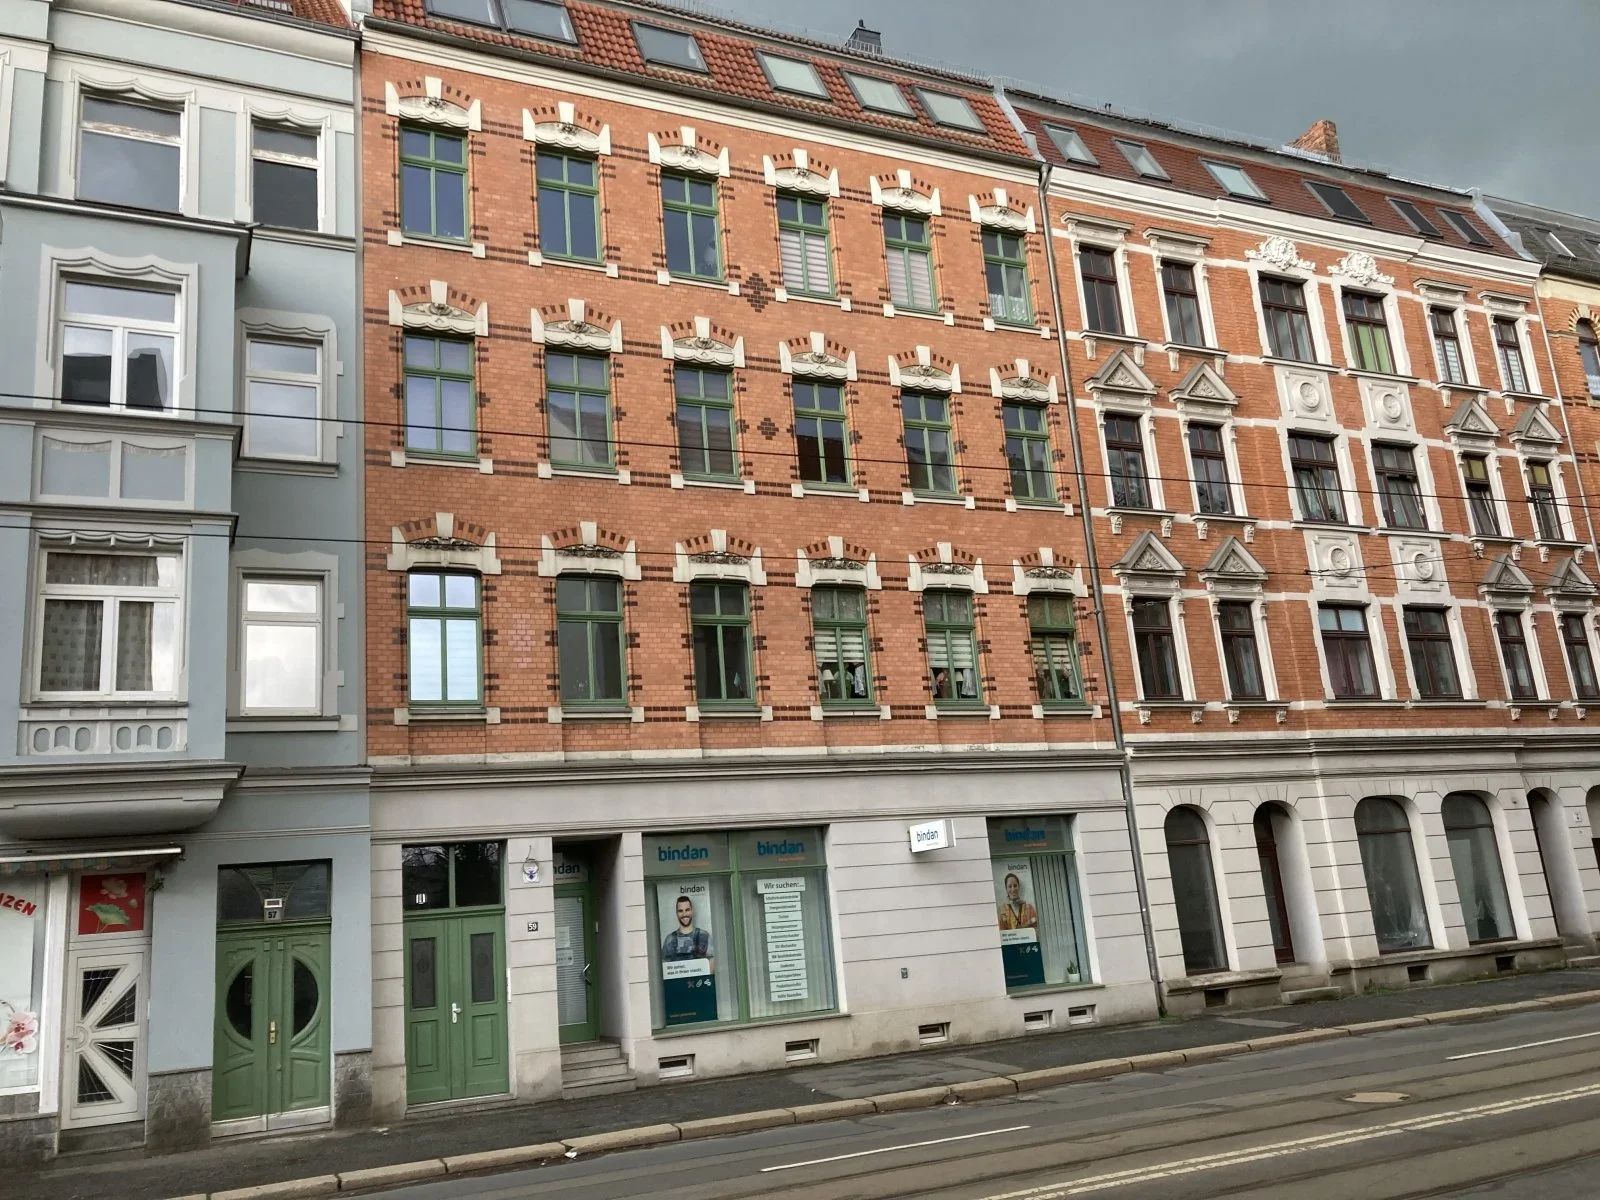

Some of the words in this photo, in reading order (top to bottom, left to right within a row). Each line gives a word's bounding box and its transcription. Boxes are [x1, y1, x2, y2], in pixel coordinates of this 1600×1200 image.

[916, 829, 938, 842] bindan
[757, 840, 804, 856] bindan
[658, 845, 708, 862] bindan
[680, 885, 705, 893] bindan
[268, 911, 277, 919] 57
[528, 923, 537, 931] 59
